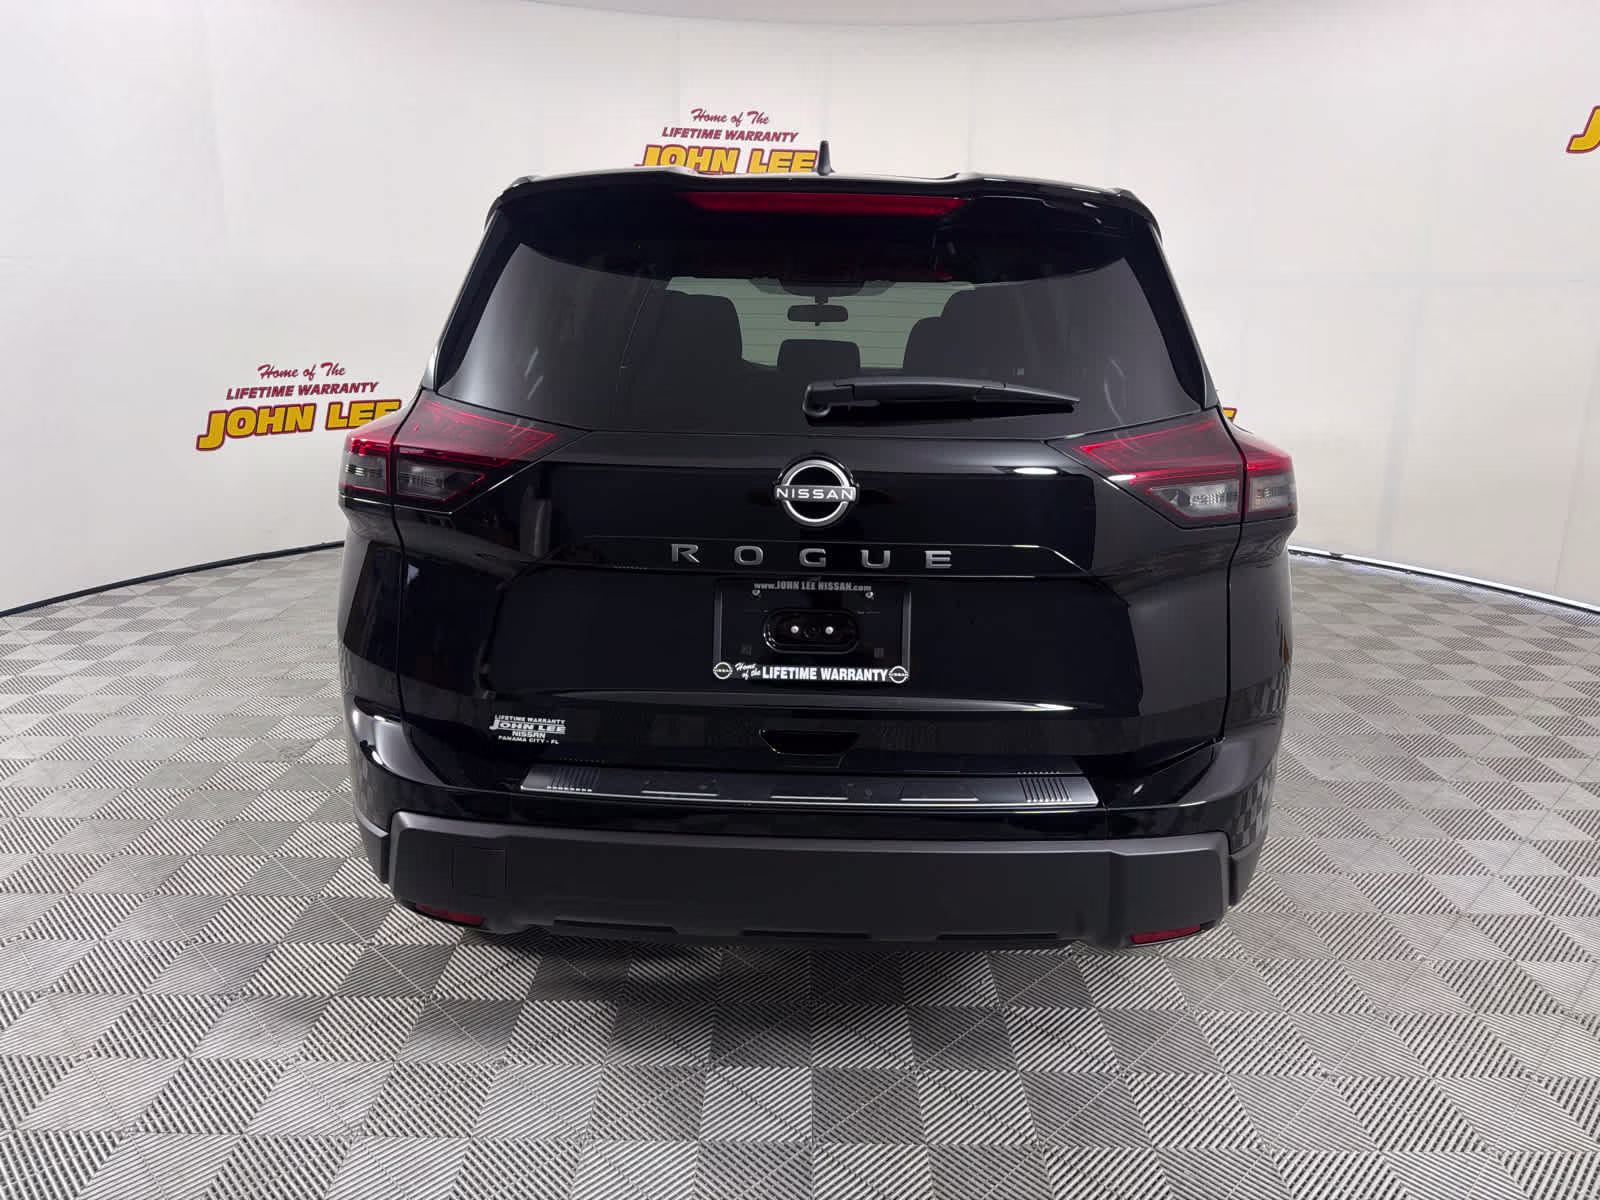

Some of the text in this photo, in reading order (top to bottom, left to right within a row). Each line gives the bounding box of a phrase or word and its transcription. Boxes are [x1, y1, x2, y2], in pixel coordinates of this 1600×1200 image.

[690, 108, 770, 127] Home of The
[661, 127, 799, 142] LIFETIME WARRANTY
[634, 144, 818, 175] JOHN LEE
[257, 362, 346, 381] Home of The
[226, 382, 378, 400] LIFETIME WARRANTY
[196, 403, 317, 451] JOHN
[776, 486, 855, 500] NISSAN
[671, 543, 953, 569] ROGUE
[801, 582, 816, 591] LEE
[734, 661, 757, 672] Home
[762, 666, 889, 682] LIFETIME WARRANTY
[489, 719, 566, 735] JOHN LEE
[527, 717, 566, 725] WARRANTY
[511, 730, 546, 739] NISSAN
